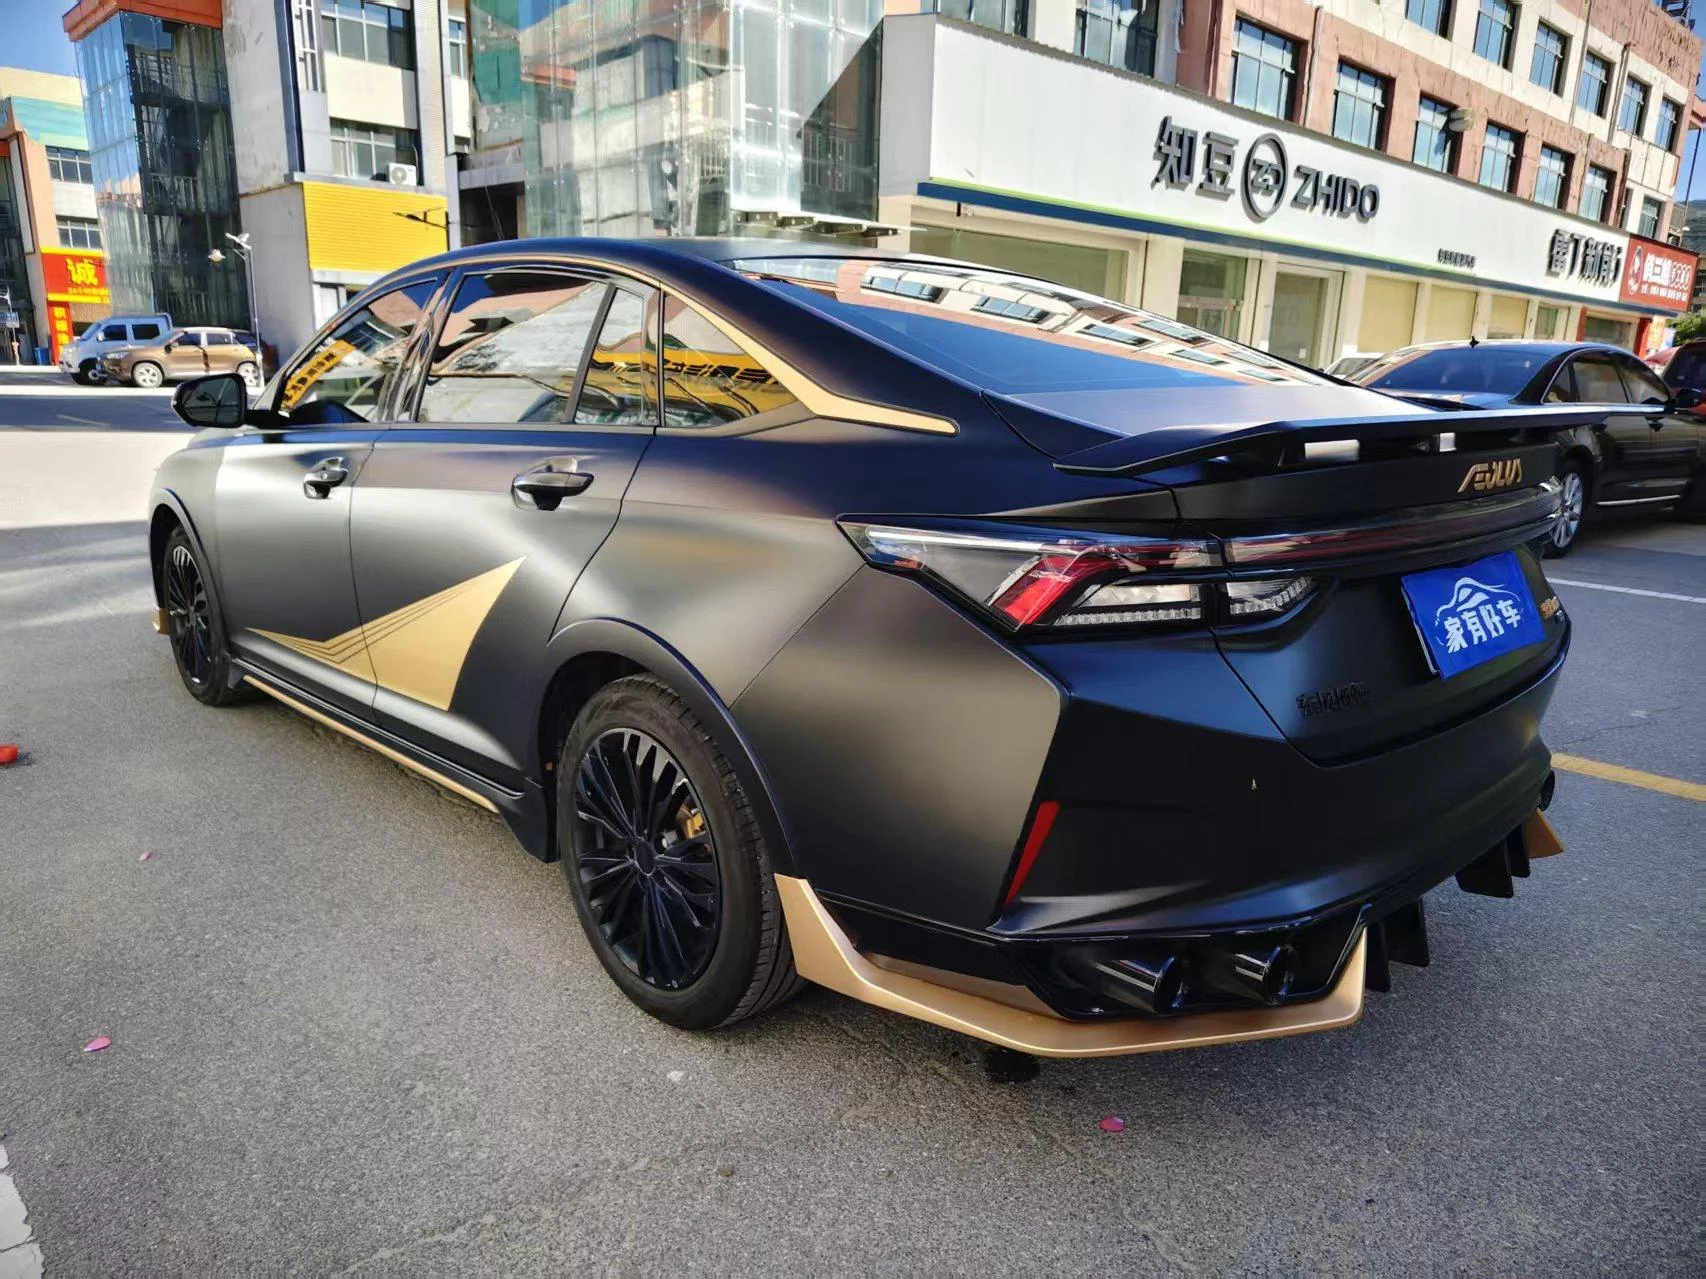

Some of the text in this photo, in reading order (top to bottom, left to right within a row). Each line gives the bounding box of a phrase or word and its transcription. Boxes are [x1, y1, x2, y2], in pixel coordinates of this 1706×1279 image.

[1151, 116, 1240, 198] 知豆
[1291, 164, 1380, 221] ZHIDO
[1443, 599, 1521, 654] 家有好车
